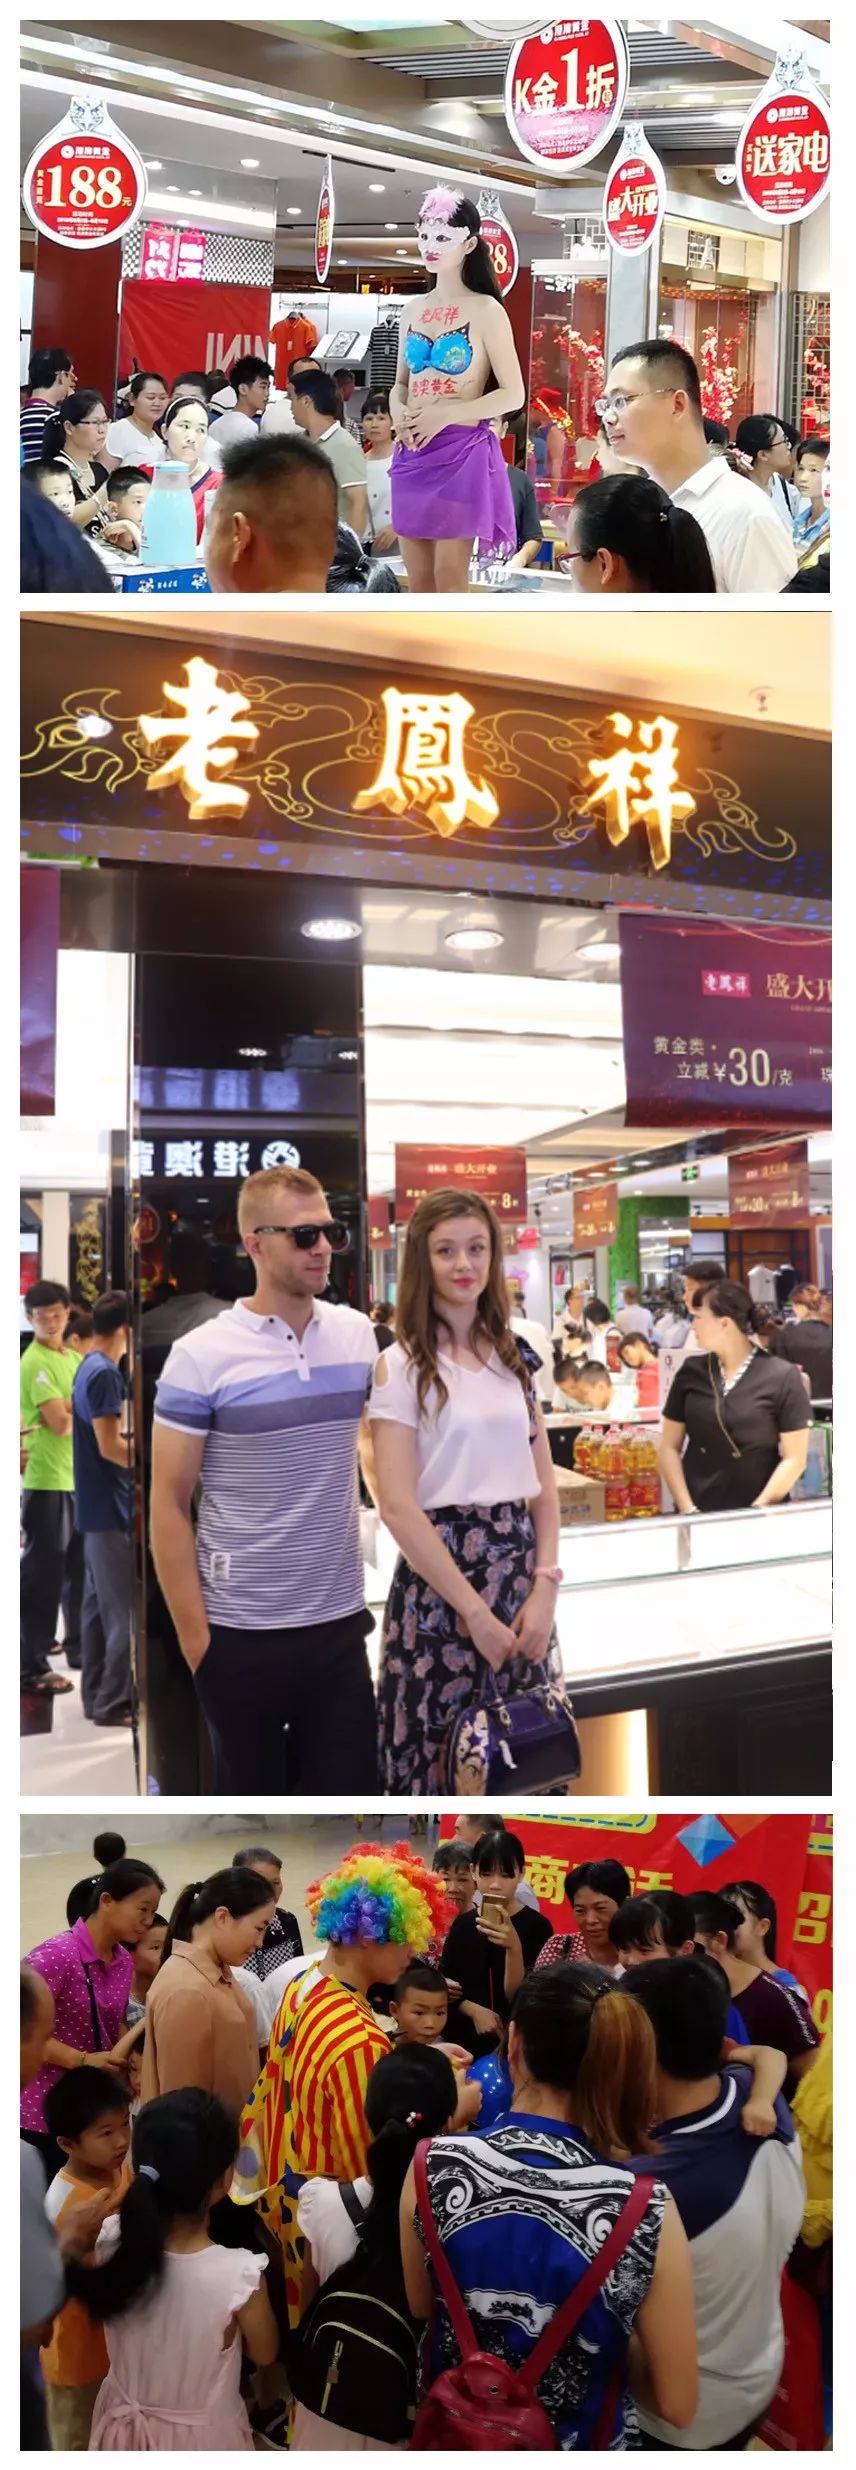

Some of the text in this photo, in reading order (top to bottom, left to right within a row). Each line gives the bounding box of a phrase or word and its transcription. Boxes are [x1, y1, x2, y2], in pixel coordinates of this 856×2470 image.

[515, 47, 615, 115] K金1折
[752, 130, 832, 177] 送家电
[607, 186, 659, 222] 盛大开业
[138, 656, 697, 868] 老鳳祥
